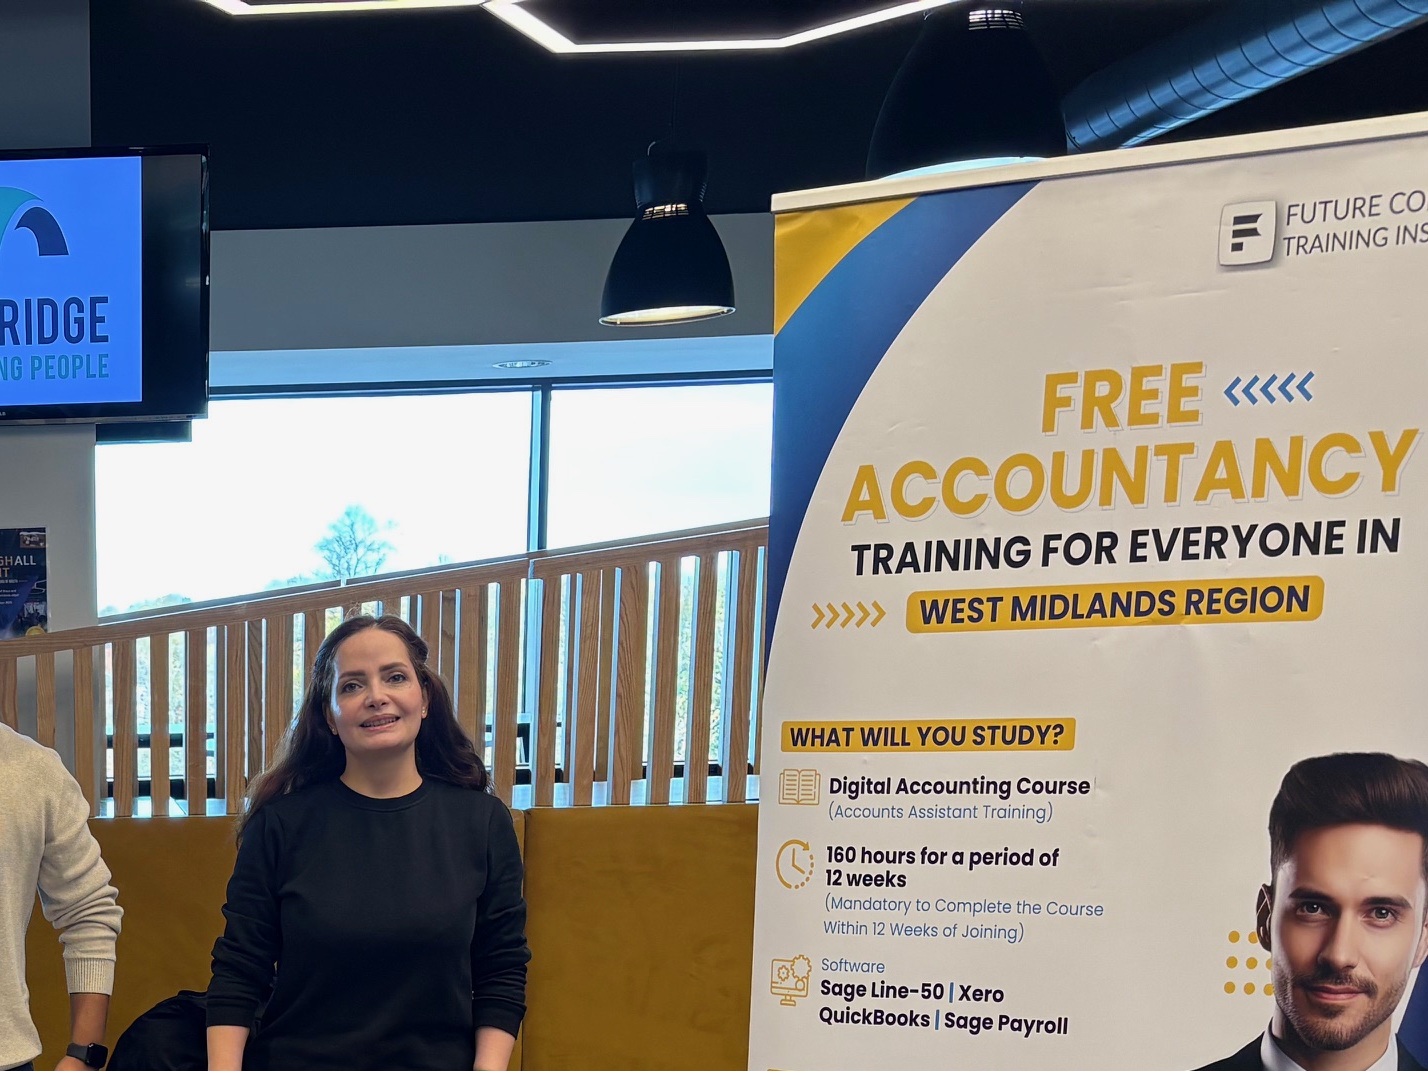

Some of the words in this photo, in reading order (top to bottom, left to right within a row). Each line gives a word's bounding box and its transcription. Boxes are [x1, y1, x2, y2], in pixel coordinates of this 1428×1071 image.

[1287, 195, 1382, 226] FUTURE
[1283, 227, 1388, 256] TRAINING
[30, 354, 108, 380] PEOPLE
[1042, 362, 1202, 432] FREE
[841, 429, 1418, 522] ACCOUNTANCY
[851, 536, 1031, 575] TRAINING
[1042, 532, 1118, 567] FOR
[1130, 520, 1346, 562] EVERYONE
[1357, 518, 1400, 553] IN
[920, 597, 1003, 624] WEST
[1011, 590, 1175, 621] MIDLANDS
[1185, 586, 1309, 615] REGION
[790, 728, 854, 746] WHAT
[860, 727, 910, 746] WILL
[917, 726, 966, 746] YOU
[973, 724, 1064, 745] STUDY?
[830, 776, 890, 800] Digital
[896, 776, 1011, 800] Accounting
[1017, 778, 1090, 794] Course
[829, 801, 903, 820] (Accounts
[908, 804, 978, 818] Assistant
[983, 802, 1052, 823] Training)
[827, 846, 856, 862] 160
[861, 847, 915, 864] hours
[921, 847, 947, 864] for
[952, 852, 964, 864] a
[969, 847, 1034, 870] period
[1039, 848, 1059, 866] of
[826, 870, 842, 886] 12
[847, 870, 906, 887] weeks
[822, 958, 884, 973] Software
[821, 980, 866, 1002] Sage
[872, 980, 944, 999] Line-50
[959, 985, 1004, 1002] Xero
[820, 1006, 930, 1026] QuickBooks
[945, 1012, 993, 1034] Sage
[999, 1015, 1068, 1038] Payroll
